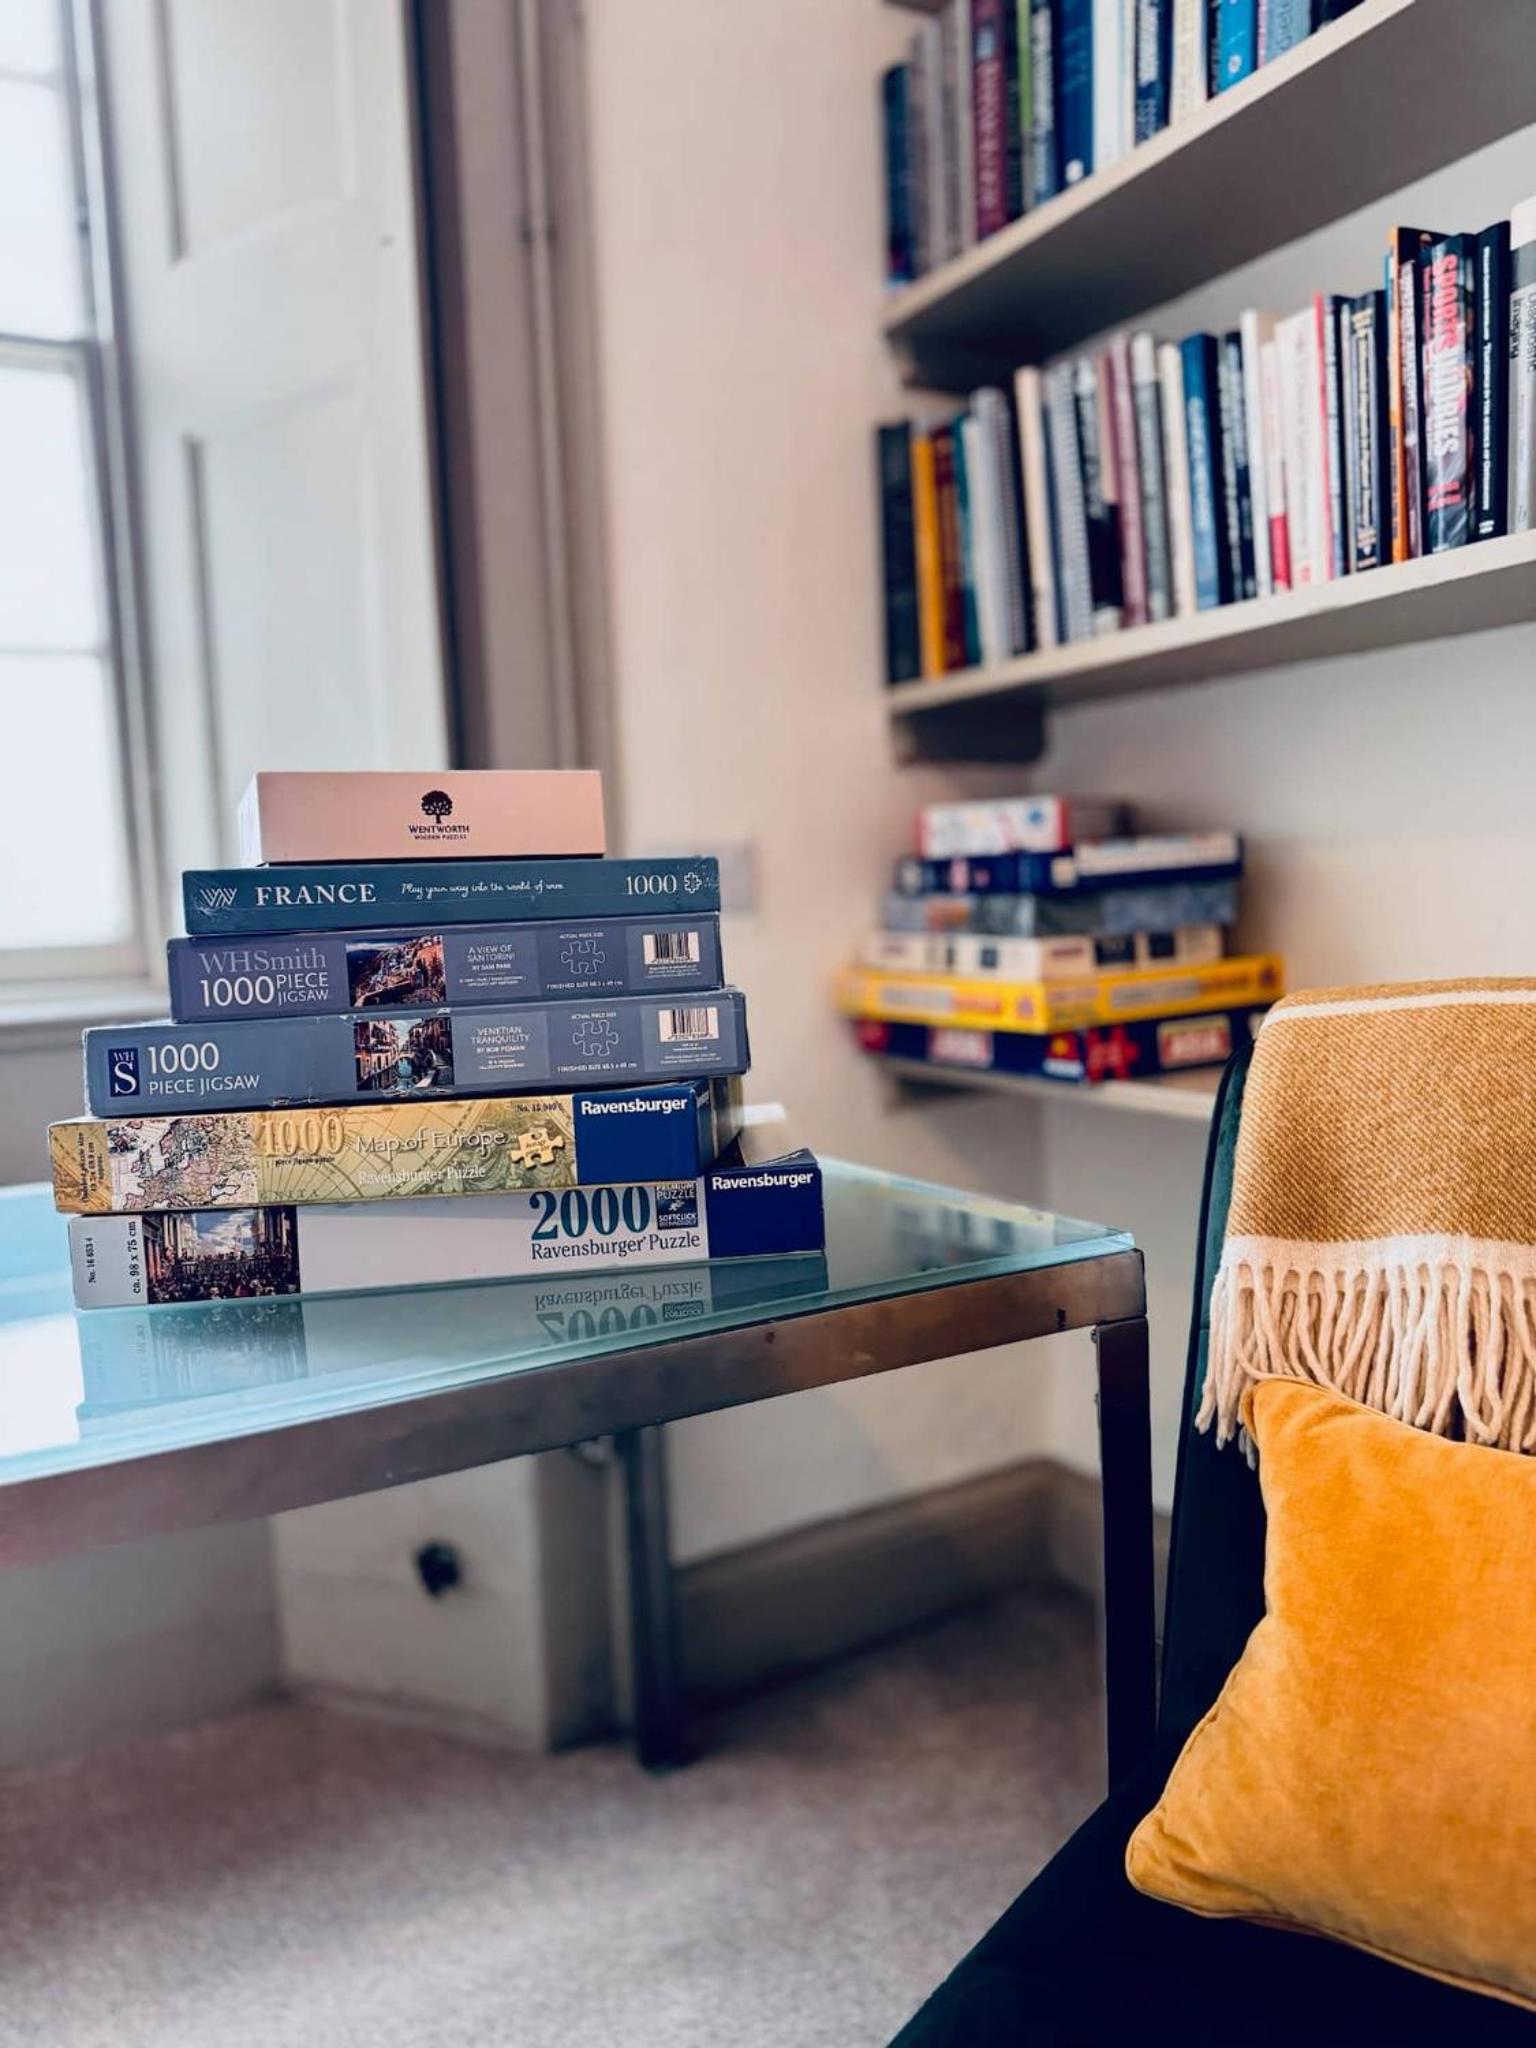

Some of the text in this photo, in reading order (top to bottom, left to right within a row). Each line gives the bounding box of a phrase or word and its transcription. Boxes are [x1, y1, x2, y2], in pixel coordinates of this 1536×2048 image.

[1431, 254, 1460, 350] SPORTS
[1509, 298, 1522, 360] Imaging
[408, 825, 470, 834] WENTWORTH
[402, 883, 423, 900] Play
[471, 881, 488, 893] into
[490, 882, 504, 892] the
[506, 881, 531, 891] world
[534, 879, 545, 894] of
[626, 874, 678, 896] 1000
[255, 884, 377, 906] FRANCE
[467, 952, 516, 962] SANTORINI
[468, 944, 513, 954] A VIEW OF
[200, 947, 327, 975] WHSmith
[276, 971, 329, 989] PIECE
[200, 975, 275, 1008] 1000
[277, 988, 329, 1006] JIGSAW
[471, 1034, 529, 1045] TRANQUILITY
[477, 1026, 522, 1036] VENETIAN
[114, 1049, 135, 1062] WH
[148, 1042, 220, 1074] 1000
[557, 1064, 587, 1072] FINISHED
[113, 1061, 137, 1095] S
[149, 1074, 261, 1096] PIECE JIGSAW
[581, 1097, 688, 1116] Ravensburger
[262, 1116, 345, 1157] 1000
[357, 1135, 400, 1161] Map
[402, 1126, 428, 1151] of
[431, 1129, 507, 1158] Europe
[359, 1164, 486, 1187] Ravensburger Puzzle
[712, 1172, 813, 1191] Ravensburger
[657, 1190, 696, 1200] PUZZLE
[529, 1186, 650, 1240] 2000
[658, 1212, 697, 1223] SOFTCLICK
[128, 1221, 136, 1237] cm
[127, 1239, 138, 1253] 75
[531, 1232, 700, 1260] Ravensburger Puzzle
[88, 1269, 97, 1283] No.
[128, 1263, 139, 1277] 98
[132, 1278, 141, 1294] ca.
